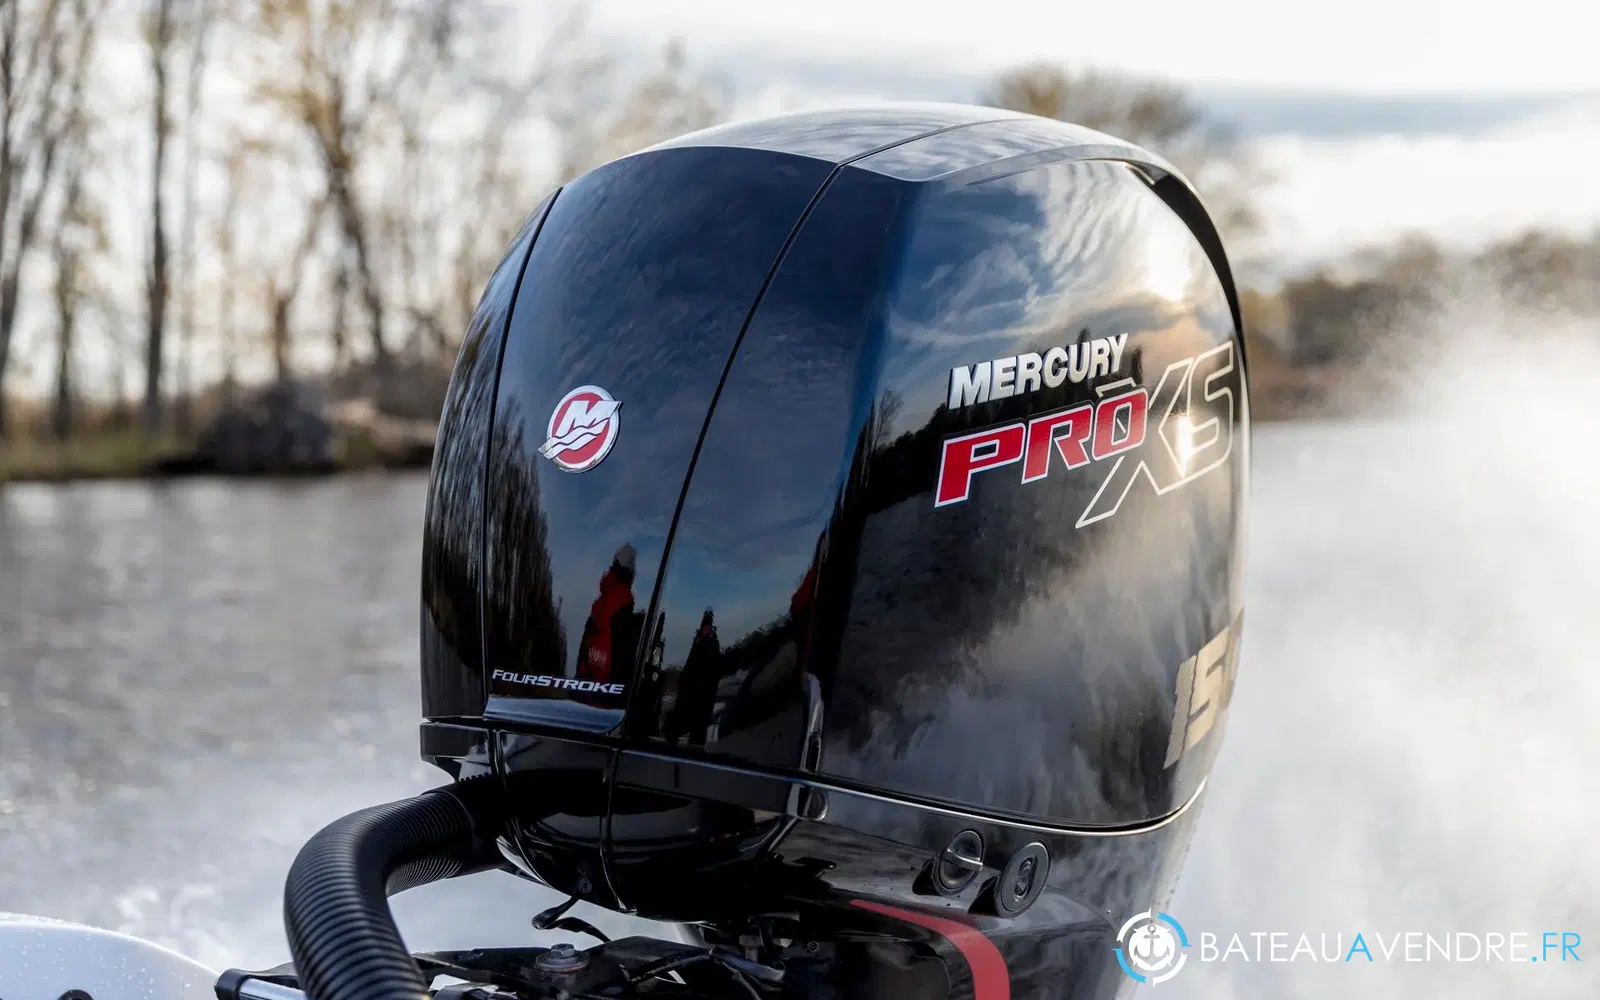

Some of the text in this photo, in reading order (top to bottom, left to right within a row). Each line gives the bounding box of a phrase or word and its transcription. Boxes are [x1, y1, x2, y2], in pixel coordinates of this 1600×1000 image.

[949, 333, 1128, 410] MERCURY
[491, 669, 625, 695] FOURSTROKE
[1163, 609, 1243, 769] 15
